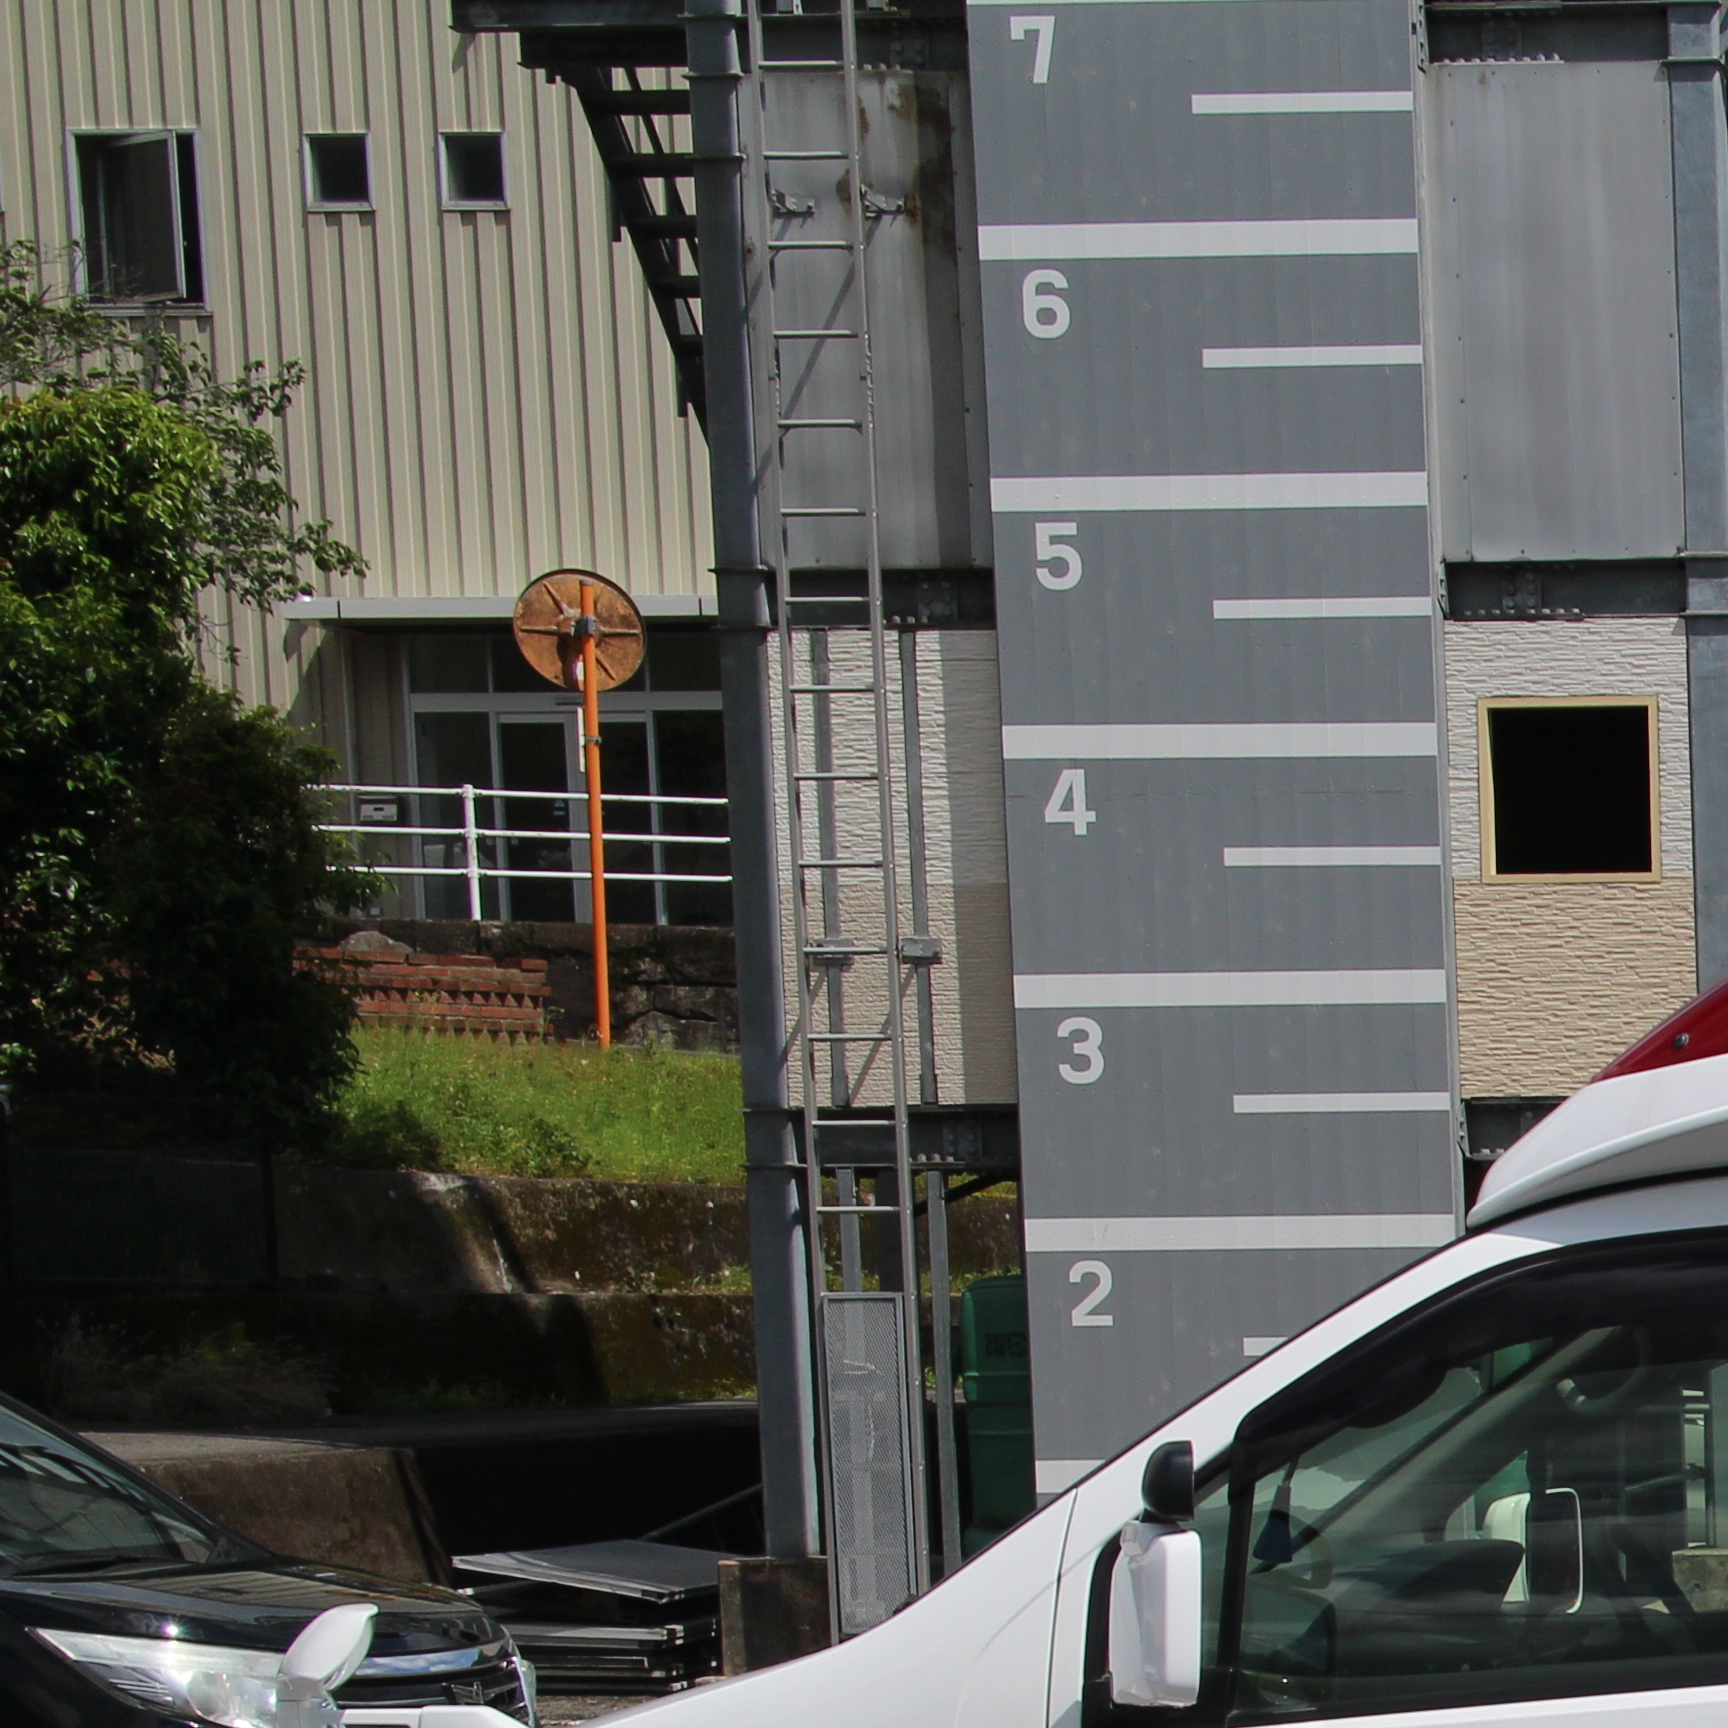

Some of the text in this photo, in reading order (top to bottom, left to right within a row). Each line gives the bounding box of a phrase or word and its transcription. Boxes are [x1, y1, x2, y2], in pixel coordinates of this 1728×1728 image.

[1009, 15, 1055, 84] 7
[1022, 269, 1070, 339] 6
[1035, 522, 1082, 590] 5
[1044, 768, 1096, 836] 4
[1057, 1016, 1105, 1084] 3
[1069, 1260, 1114, 1327] 2
